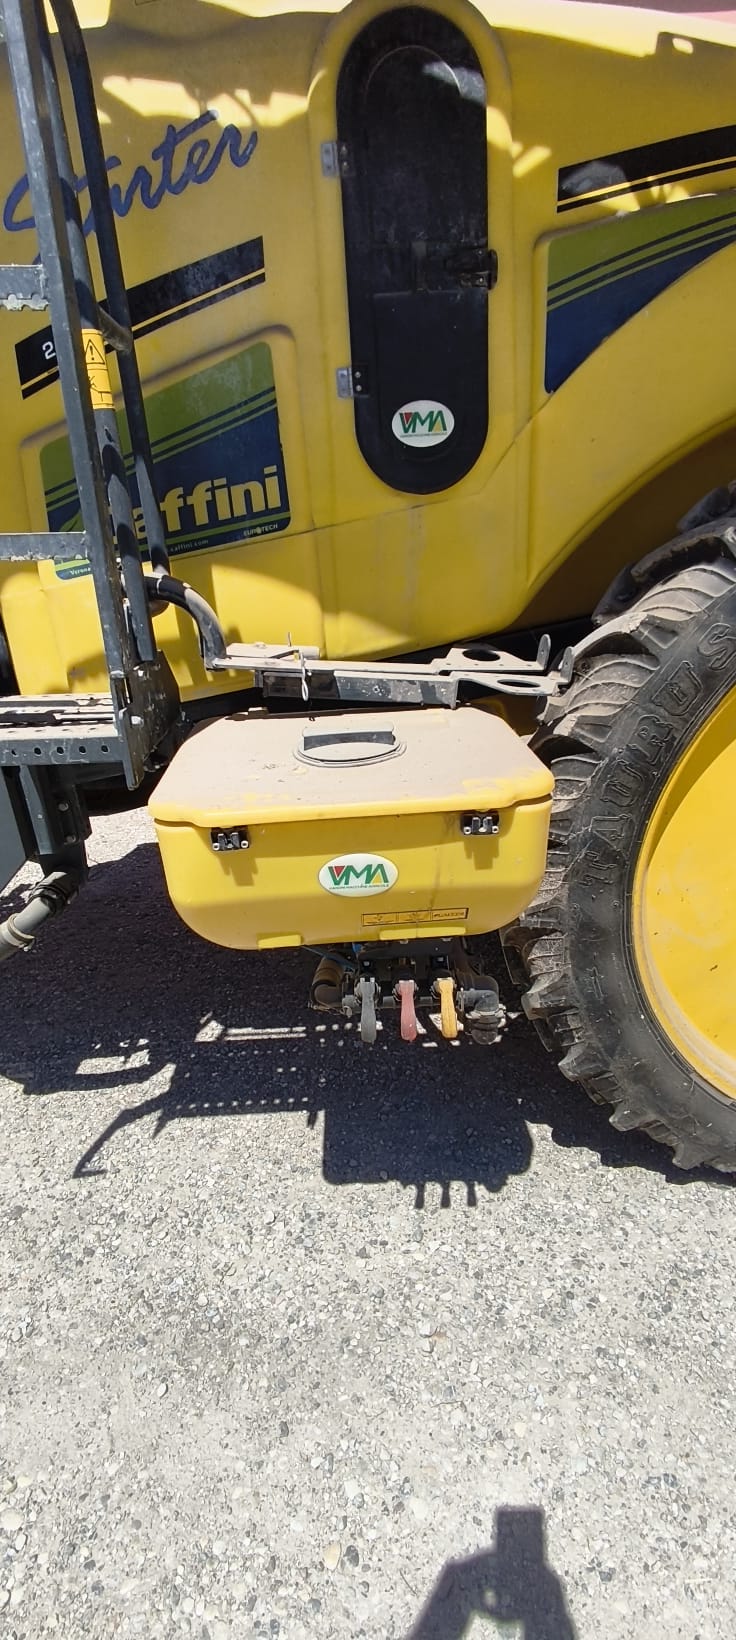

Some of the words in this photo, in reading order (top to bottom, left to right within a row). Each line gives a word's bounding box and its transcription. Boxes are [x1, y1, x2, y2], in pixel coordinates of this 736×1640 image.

[399, 410, 447, 433] VMA
[580, 622, 736, 888] TAURUS
[327, 863, 389, 886] VMA
